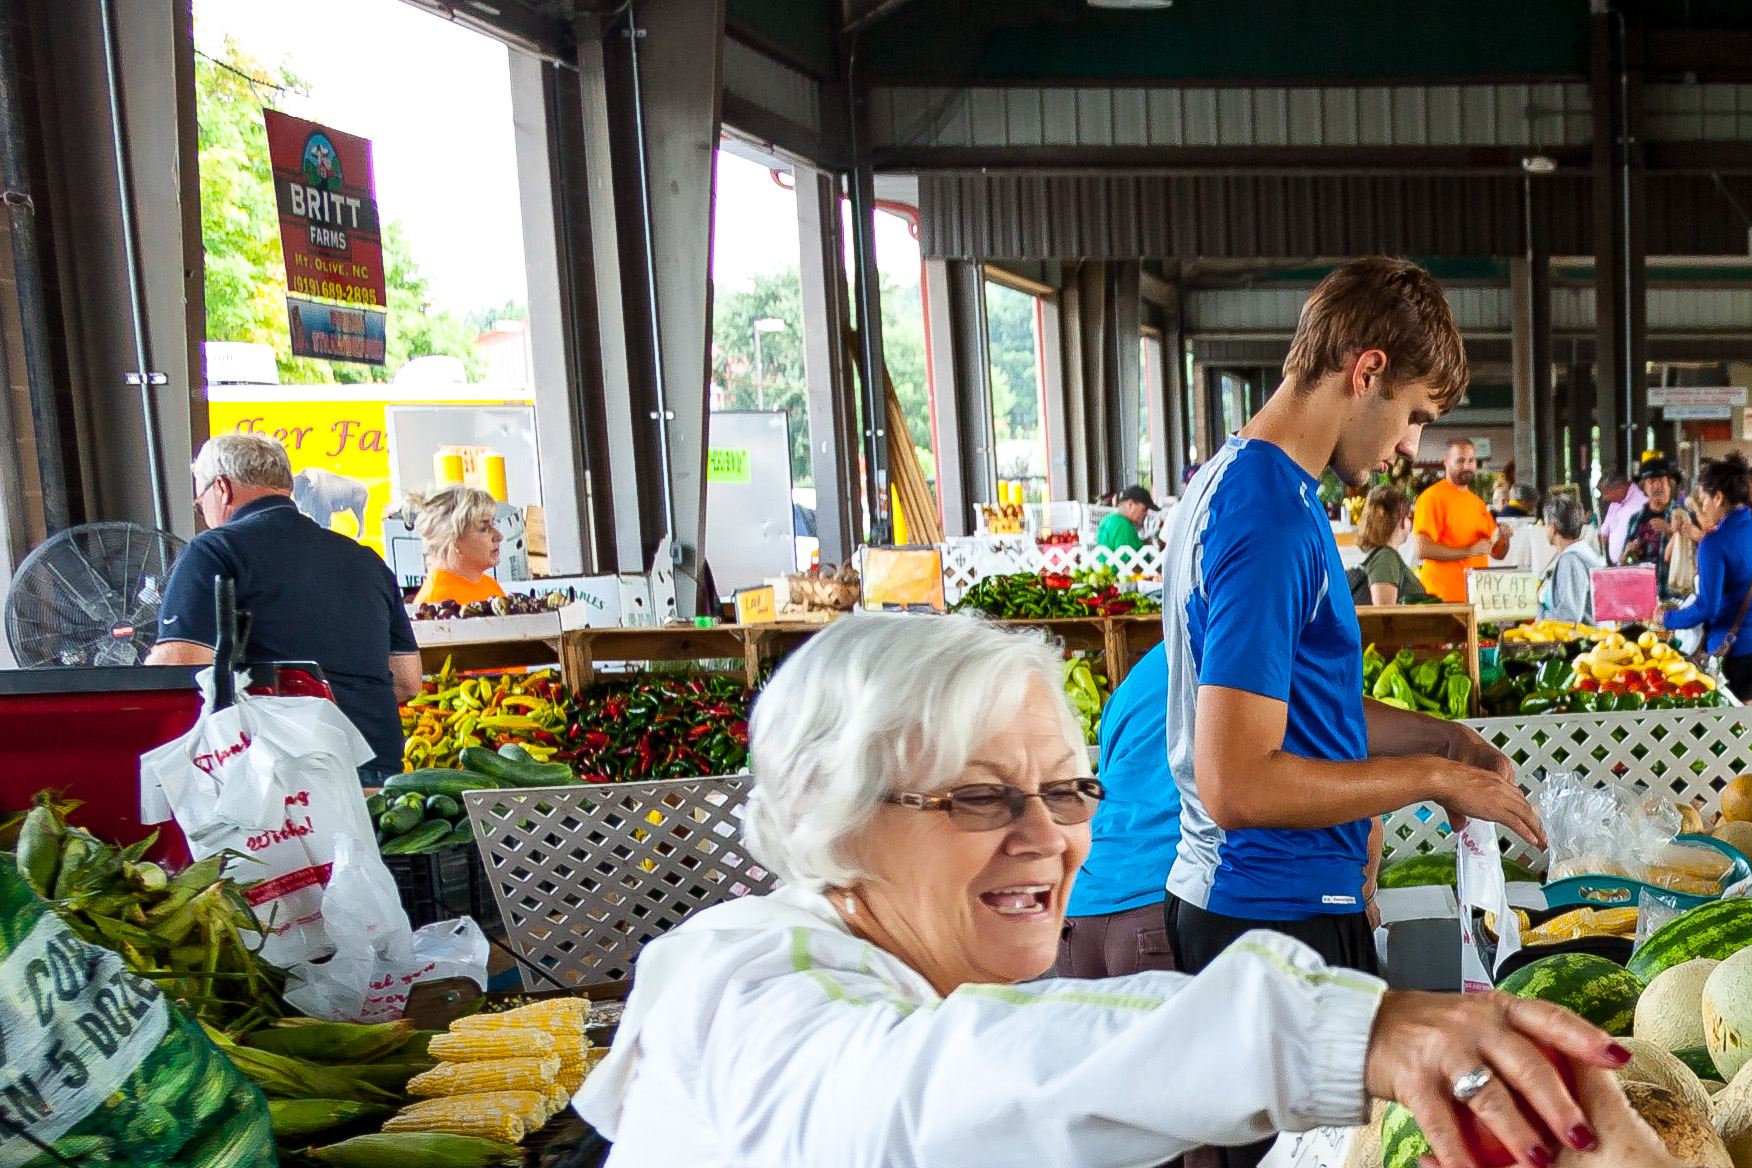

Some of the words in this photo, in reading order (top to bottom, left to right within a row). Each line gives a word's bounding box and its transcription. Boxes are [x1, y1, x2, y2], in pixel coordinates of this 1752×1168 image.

[289, 182, 361, 229] BRITT
[310, 225, 346, 250] FARMS
[352, 264, 369, 280] NC
[1475, 572, 1505, 592] PAY
[1511, 575, 1532, 592] AT
